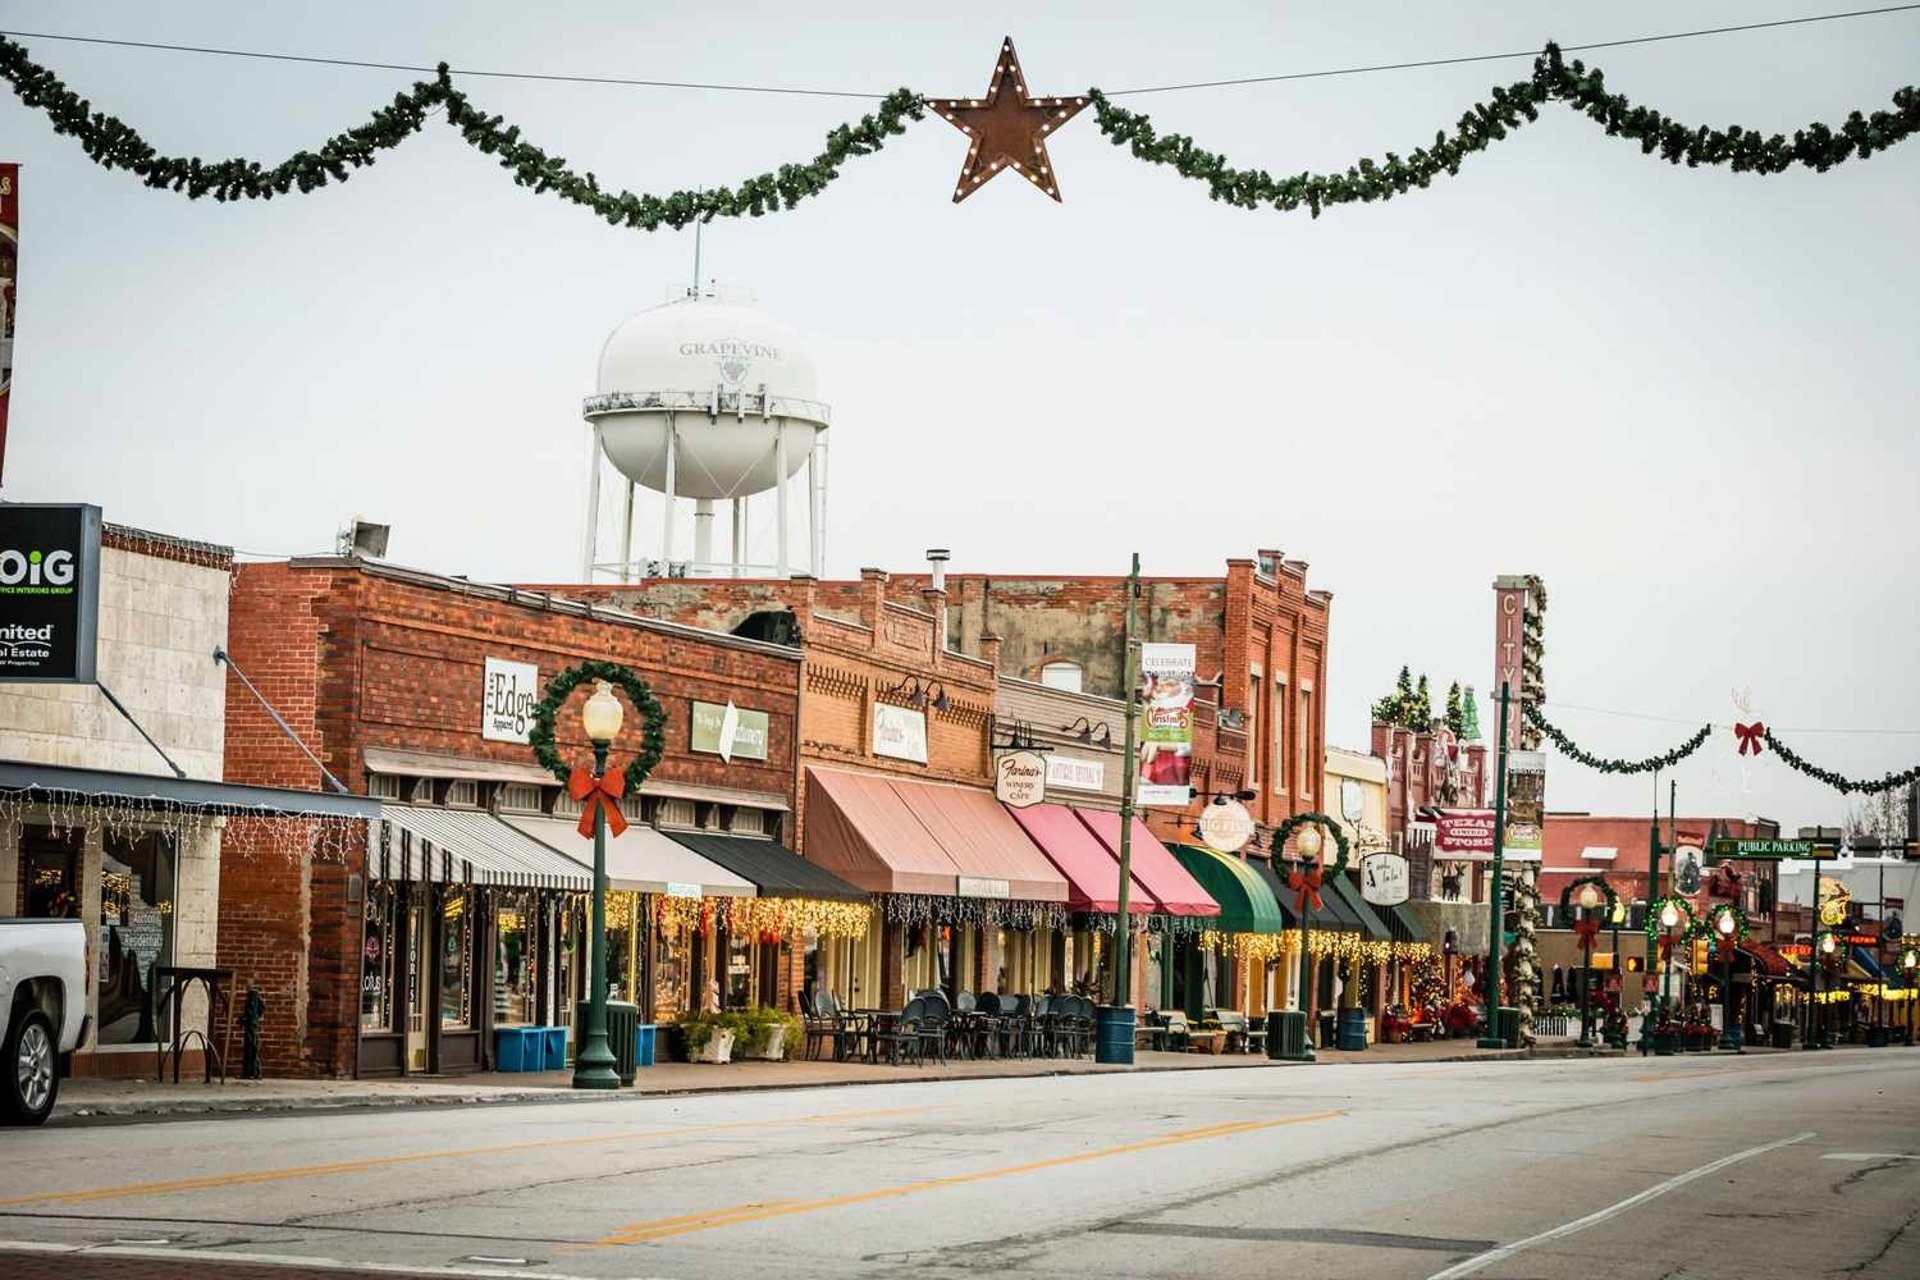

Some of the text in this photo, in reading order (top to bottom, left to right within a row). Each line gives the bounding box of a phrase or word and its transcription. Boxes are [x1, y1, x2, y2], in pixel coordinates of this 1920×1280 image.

[679, 342, 780, 360] GRAPEVINE
[1503, 594, 1515, 683] CITY
[11, 647, 49, 658] Estate
[494, 673, 534, 735] Edge
[1442, 819, 1495, 828] TEXAS
[1443, 837, 1494, 846] STORE
[1738, 841, 1811, 852] PUBLIC PARKING
